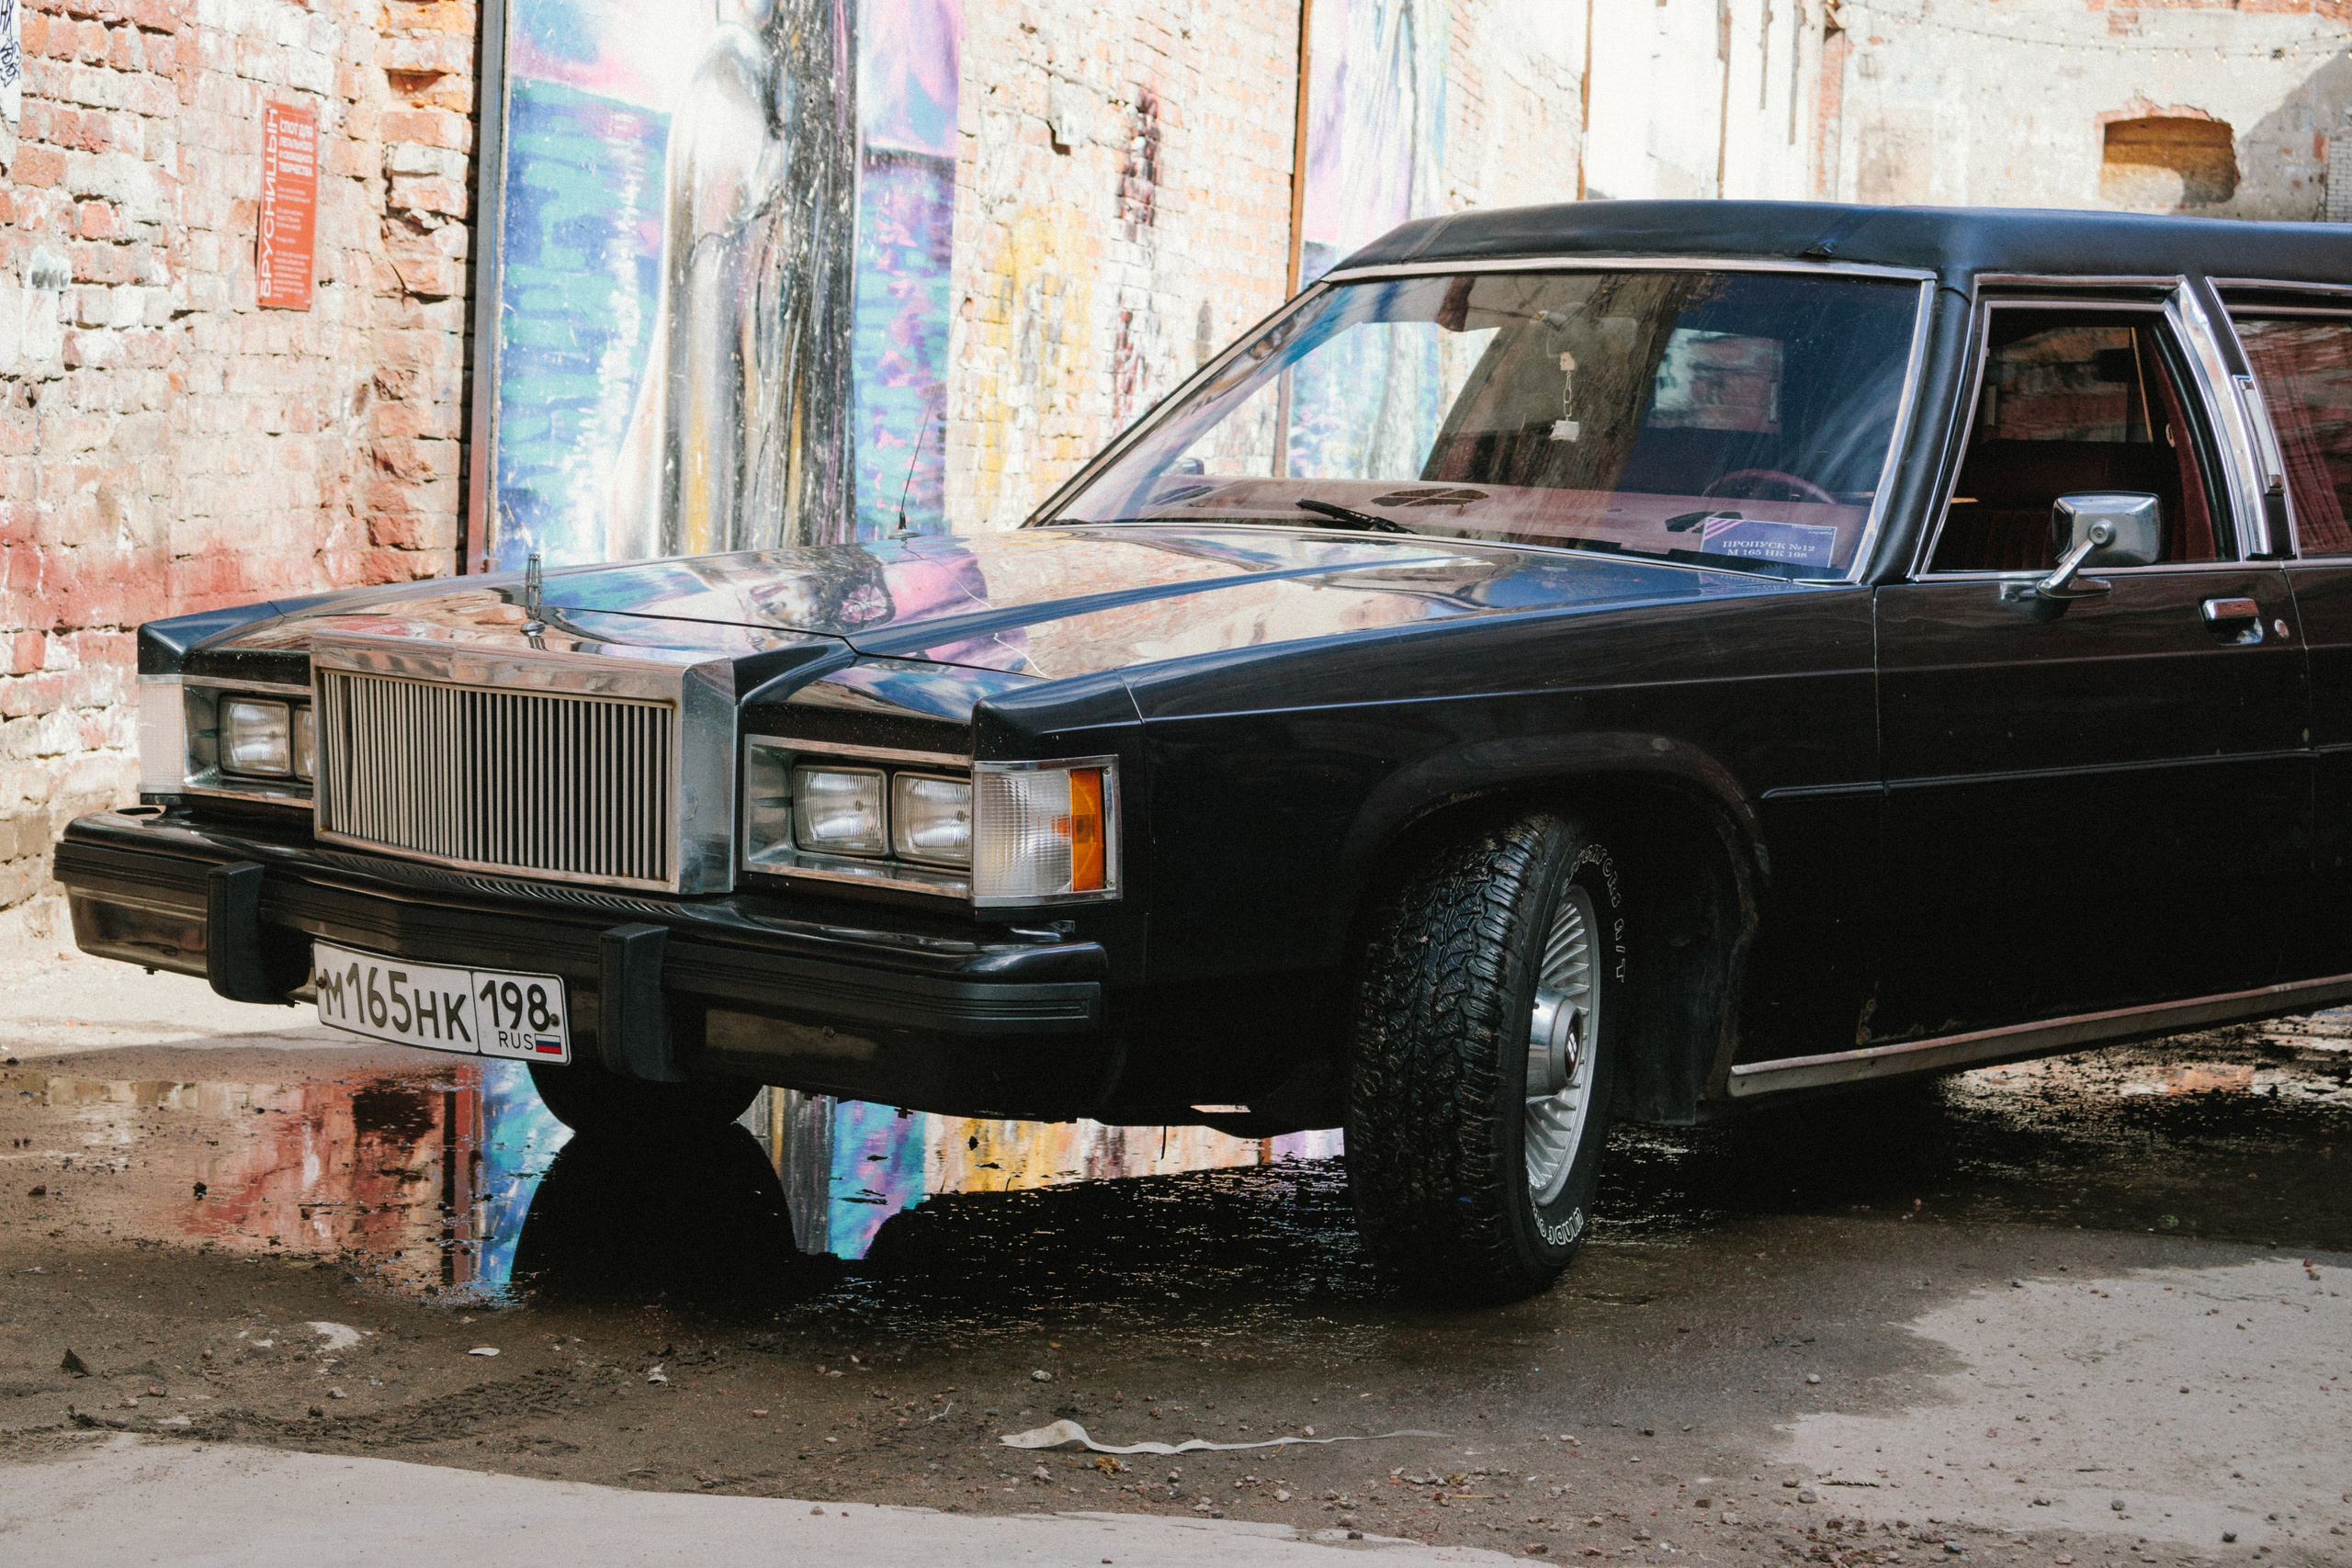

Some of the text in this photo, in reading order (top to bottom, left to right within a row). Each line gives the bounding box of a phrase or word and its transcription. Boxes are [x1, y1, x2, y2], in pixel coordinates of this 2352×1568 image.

[260, 107, 278, 298] БРУСНИЦЫН
[1723, 540, 1786, 550] ПРОПУСК
[479, 979, 550, 1032] 198
[498, 1030, 534, 1051] RUS
